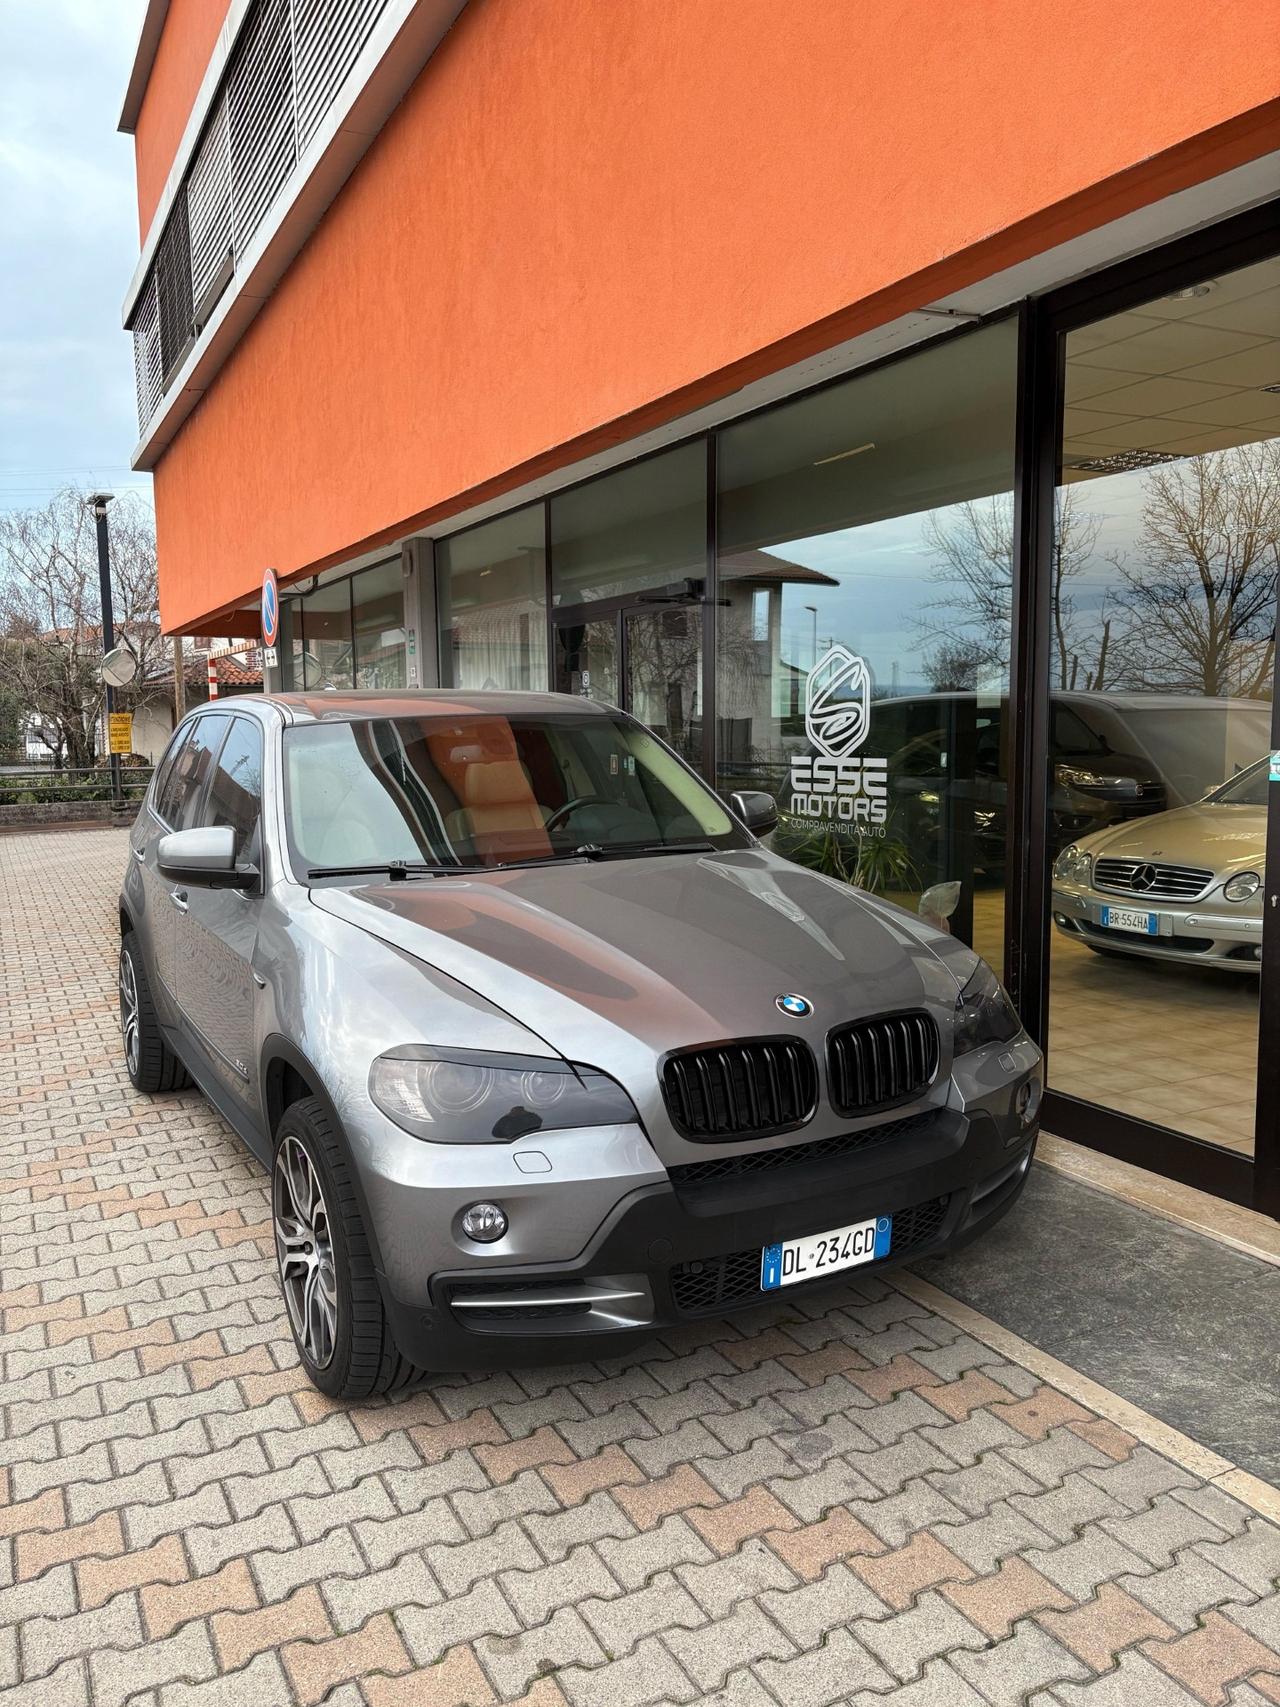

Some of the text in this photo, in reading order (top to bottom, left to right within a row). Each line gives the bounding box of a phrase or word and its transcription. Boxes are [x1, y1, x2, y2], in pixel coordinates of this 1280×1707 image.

[791, 756, 888, 797] ESSE
[790, 792, 887, 824] MOTORS
[790, 818, 887, 839] COMPRAVENDITA AUTO
[782, 1227, 876, 1277] DL 234GD
